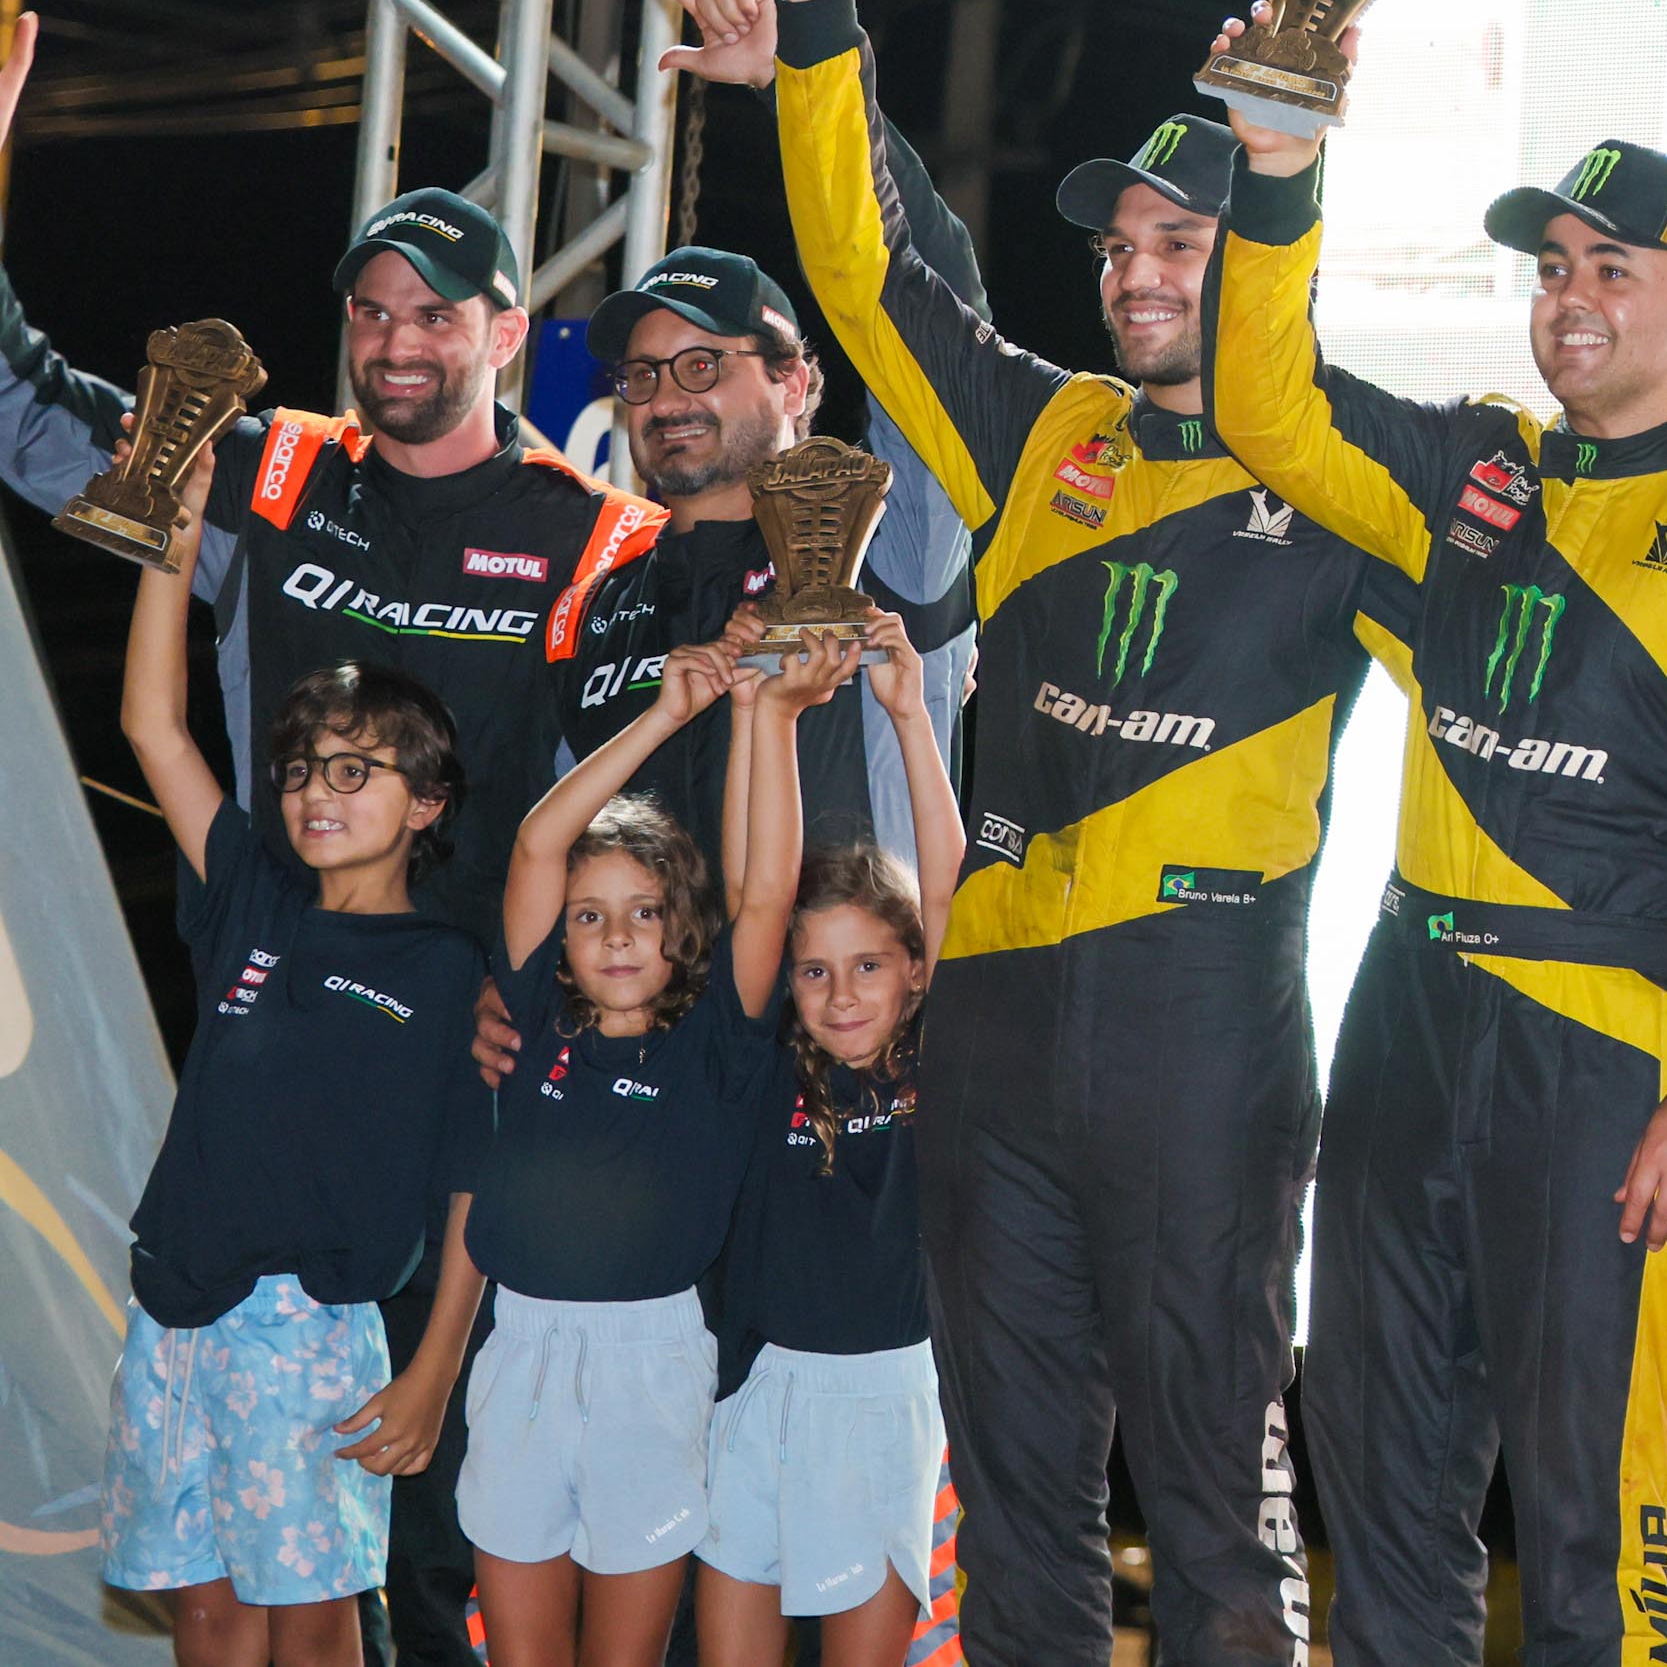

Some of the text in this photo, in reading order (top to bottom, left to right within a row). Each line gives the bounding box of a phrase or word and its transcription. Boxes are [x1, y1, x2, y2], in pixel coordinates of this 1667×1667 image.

[466, 551, 543, 579] MOTUL
[349, 587, 539, 635] RACING
[551, 584, 578, 649] parco
[1033, 680, 1216, 752] can-am
[1427, 705, 1608, 785] can-am
[1177, 888, 1208, 902] Bruno
[1242, 893, 1257, 905] B+
[349, 982, 414, 1019] RACING
